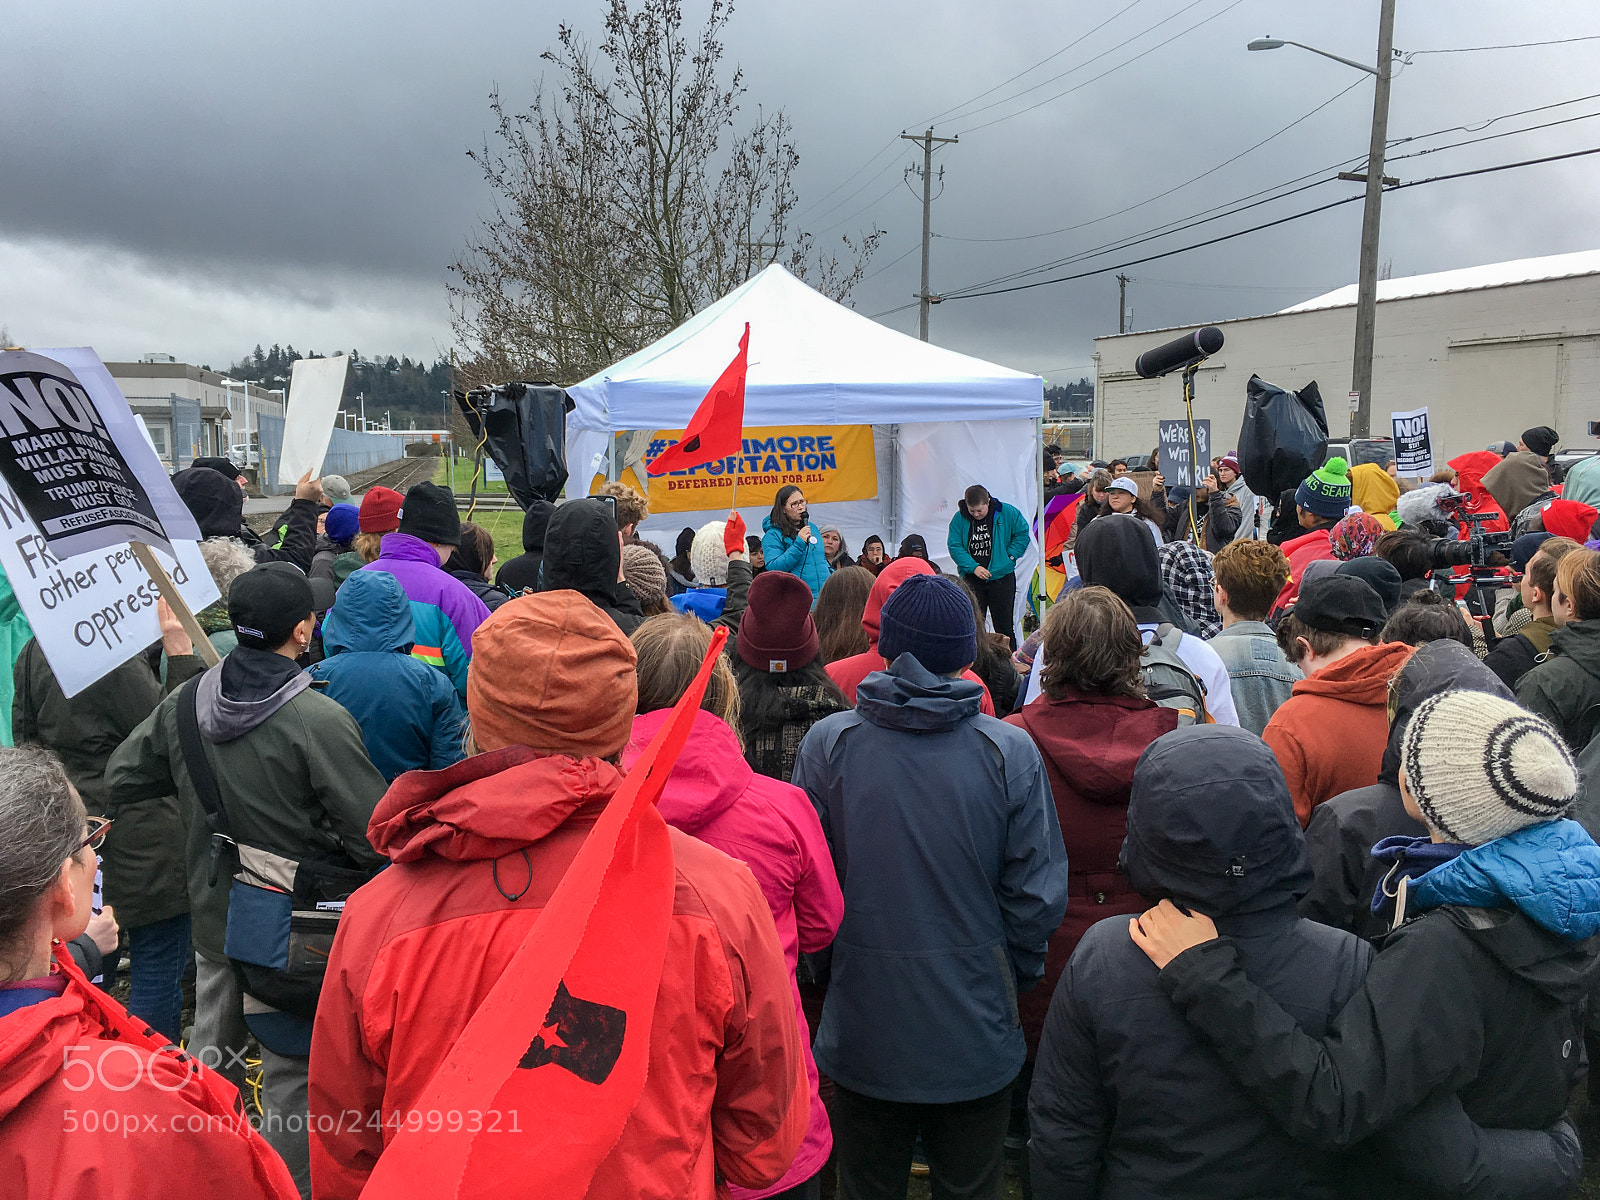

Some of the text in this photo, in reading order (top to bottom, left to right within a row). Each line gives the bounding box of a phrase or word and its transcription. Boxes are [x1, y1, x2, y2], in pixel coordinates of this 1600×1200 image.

[0, 376, 111, 441] NO!
[1395, 415, 1427, 437] NO!
[11, 431, 111, 455] MARU MORA
[15, 448, 122, 472] VILLALPANDO
[33, 462, 128, 486] MUST STAY!
[668, 473, 825, 490] DEFERRED ACTION FOR ALL
[1177, 465, 1211, 487] MRU
[43, 479, 139, 502] TRUMP/PENCE
[69, 492, 136, 510] MUST GO!
[972, 532, 991, 541] NEW
[973, 549, 990, 557] JAIL
[39, 563, 99, 610] other
[74, 561, 190, 650] oppressd
